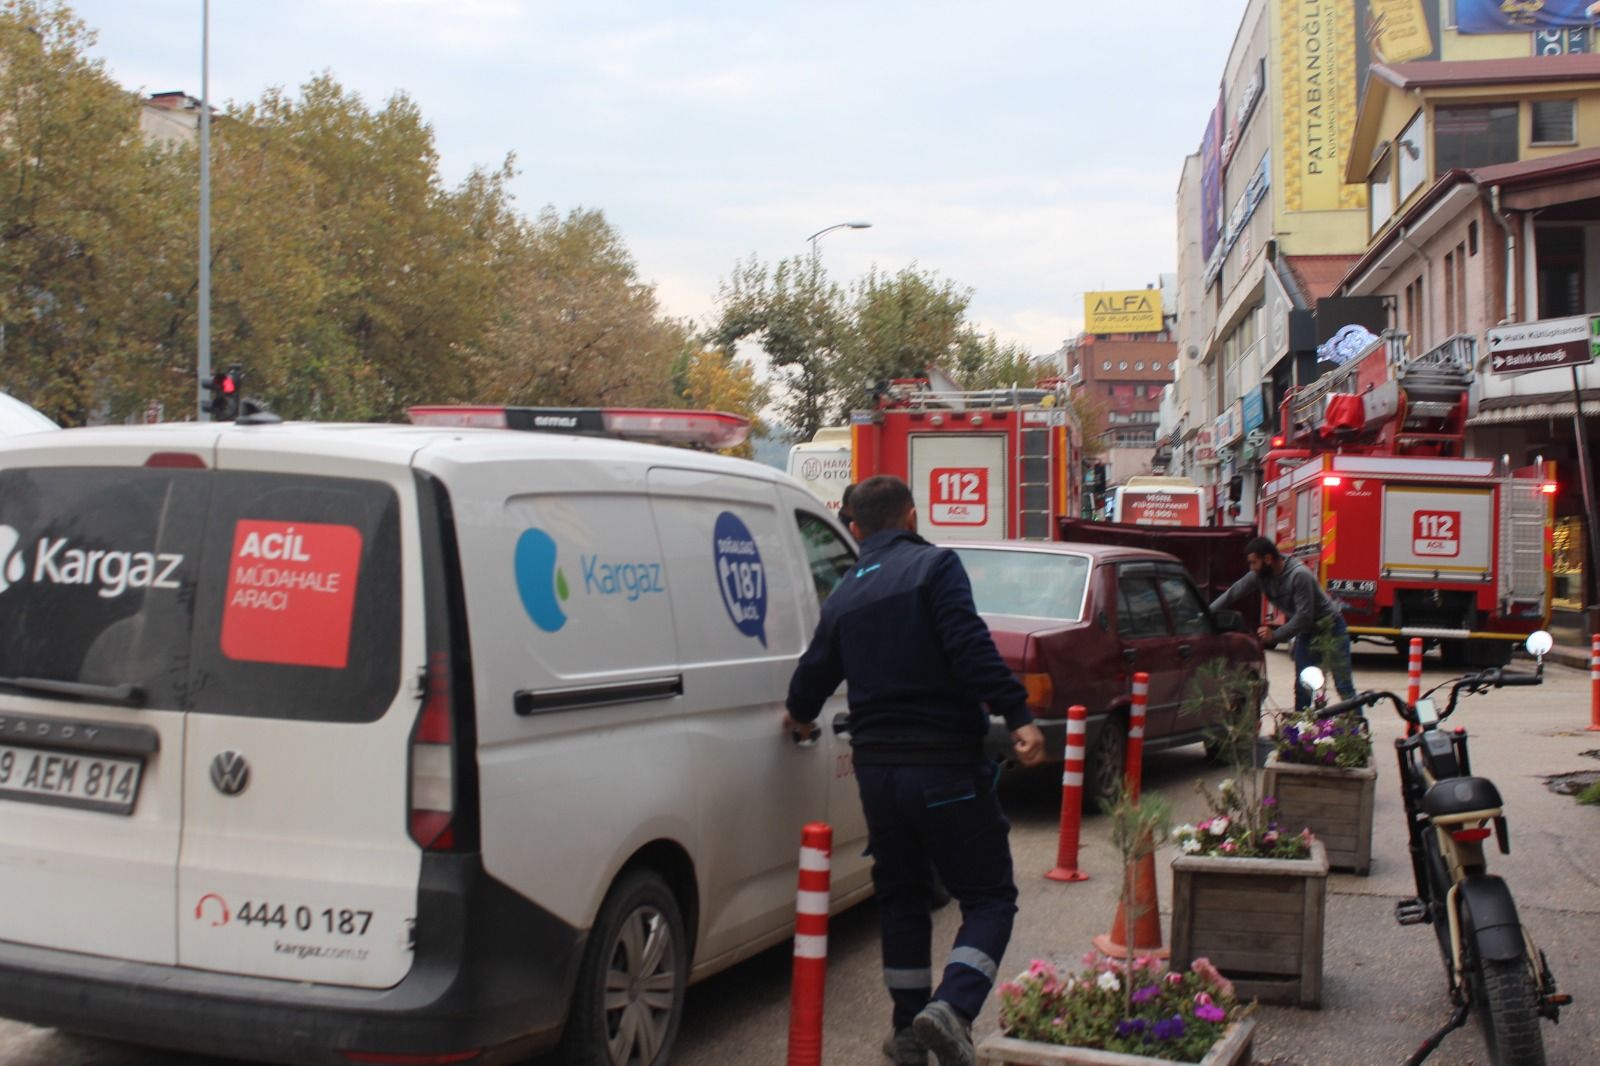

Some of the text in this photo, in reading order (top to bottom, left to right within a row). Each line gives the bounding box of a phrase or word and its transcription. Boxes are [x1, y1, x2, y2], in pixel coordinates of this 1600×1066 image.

[1300, 0, 1321, 175] PATTABANOĞL
[1094, 296, 1153, 312] ALFA
[823, 470, 852, 479] OTO
[937, 473, 979, 500] 112
[1419, 515, 1453, 538] 112
[239, 527, 310, 562] ACİL
[33, 538, 184, 598] Kargaz
[235, 564, 341, 593] MÜDAHALE
[580, 553, 664, 602] Kargaz
[730, 561, 762, 600] 187
[231, 588, 288, 611] ARACI
[22, 753, 79, 793] AEM
[84, 762, 135, 801] 814
[236, 901, 374, 936] 444 0 187
